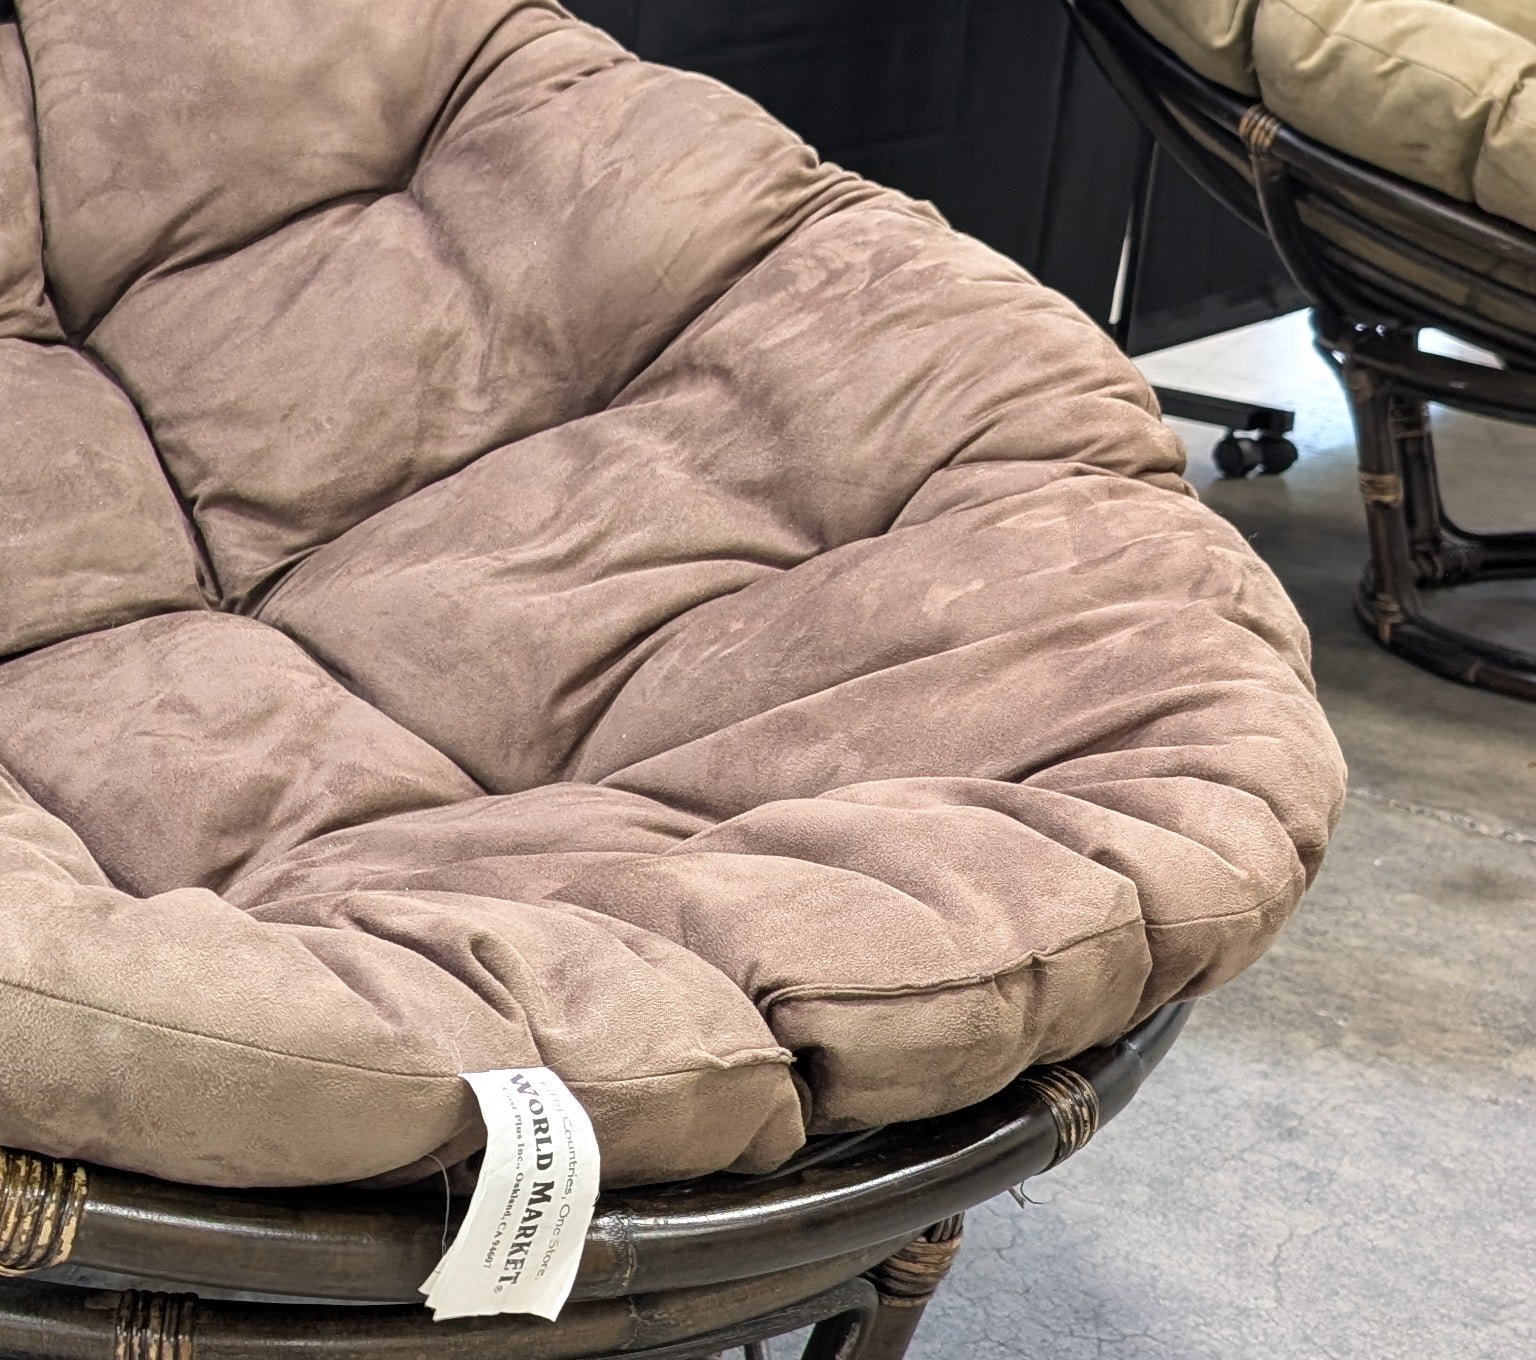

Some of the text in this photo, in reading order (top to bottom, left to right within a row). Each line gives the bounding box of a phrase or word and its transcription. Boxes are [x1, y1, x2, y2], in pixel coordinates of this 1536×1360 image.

[509, 1073, 554, 1171] WORLD
[514, 1114, 523, 1140] Plus
[561, 1116, 578, 1200] Countries,
[493, 1221, 507, 1239] CA
[552, 1204, 571, 1236] One
[534, 1239, 559, 1281] Store.
